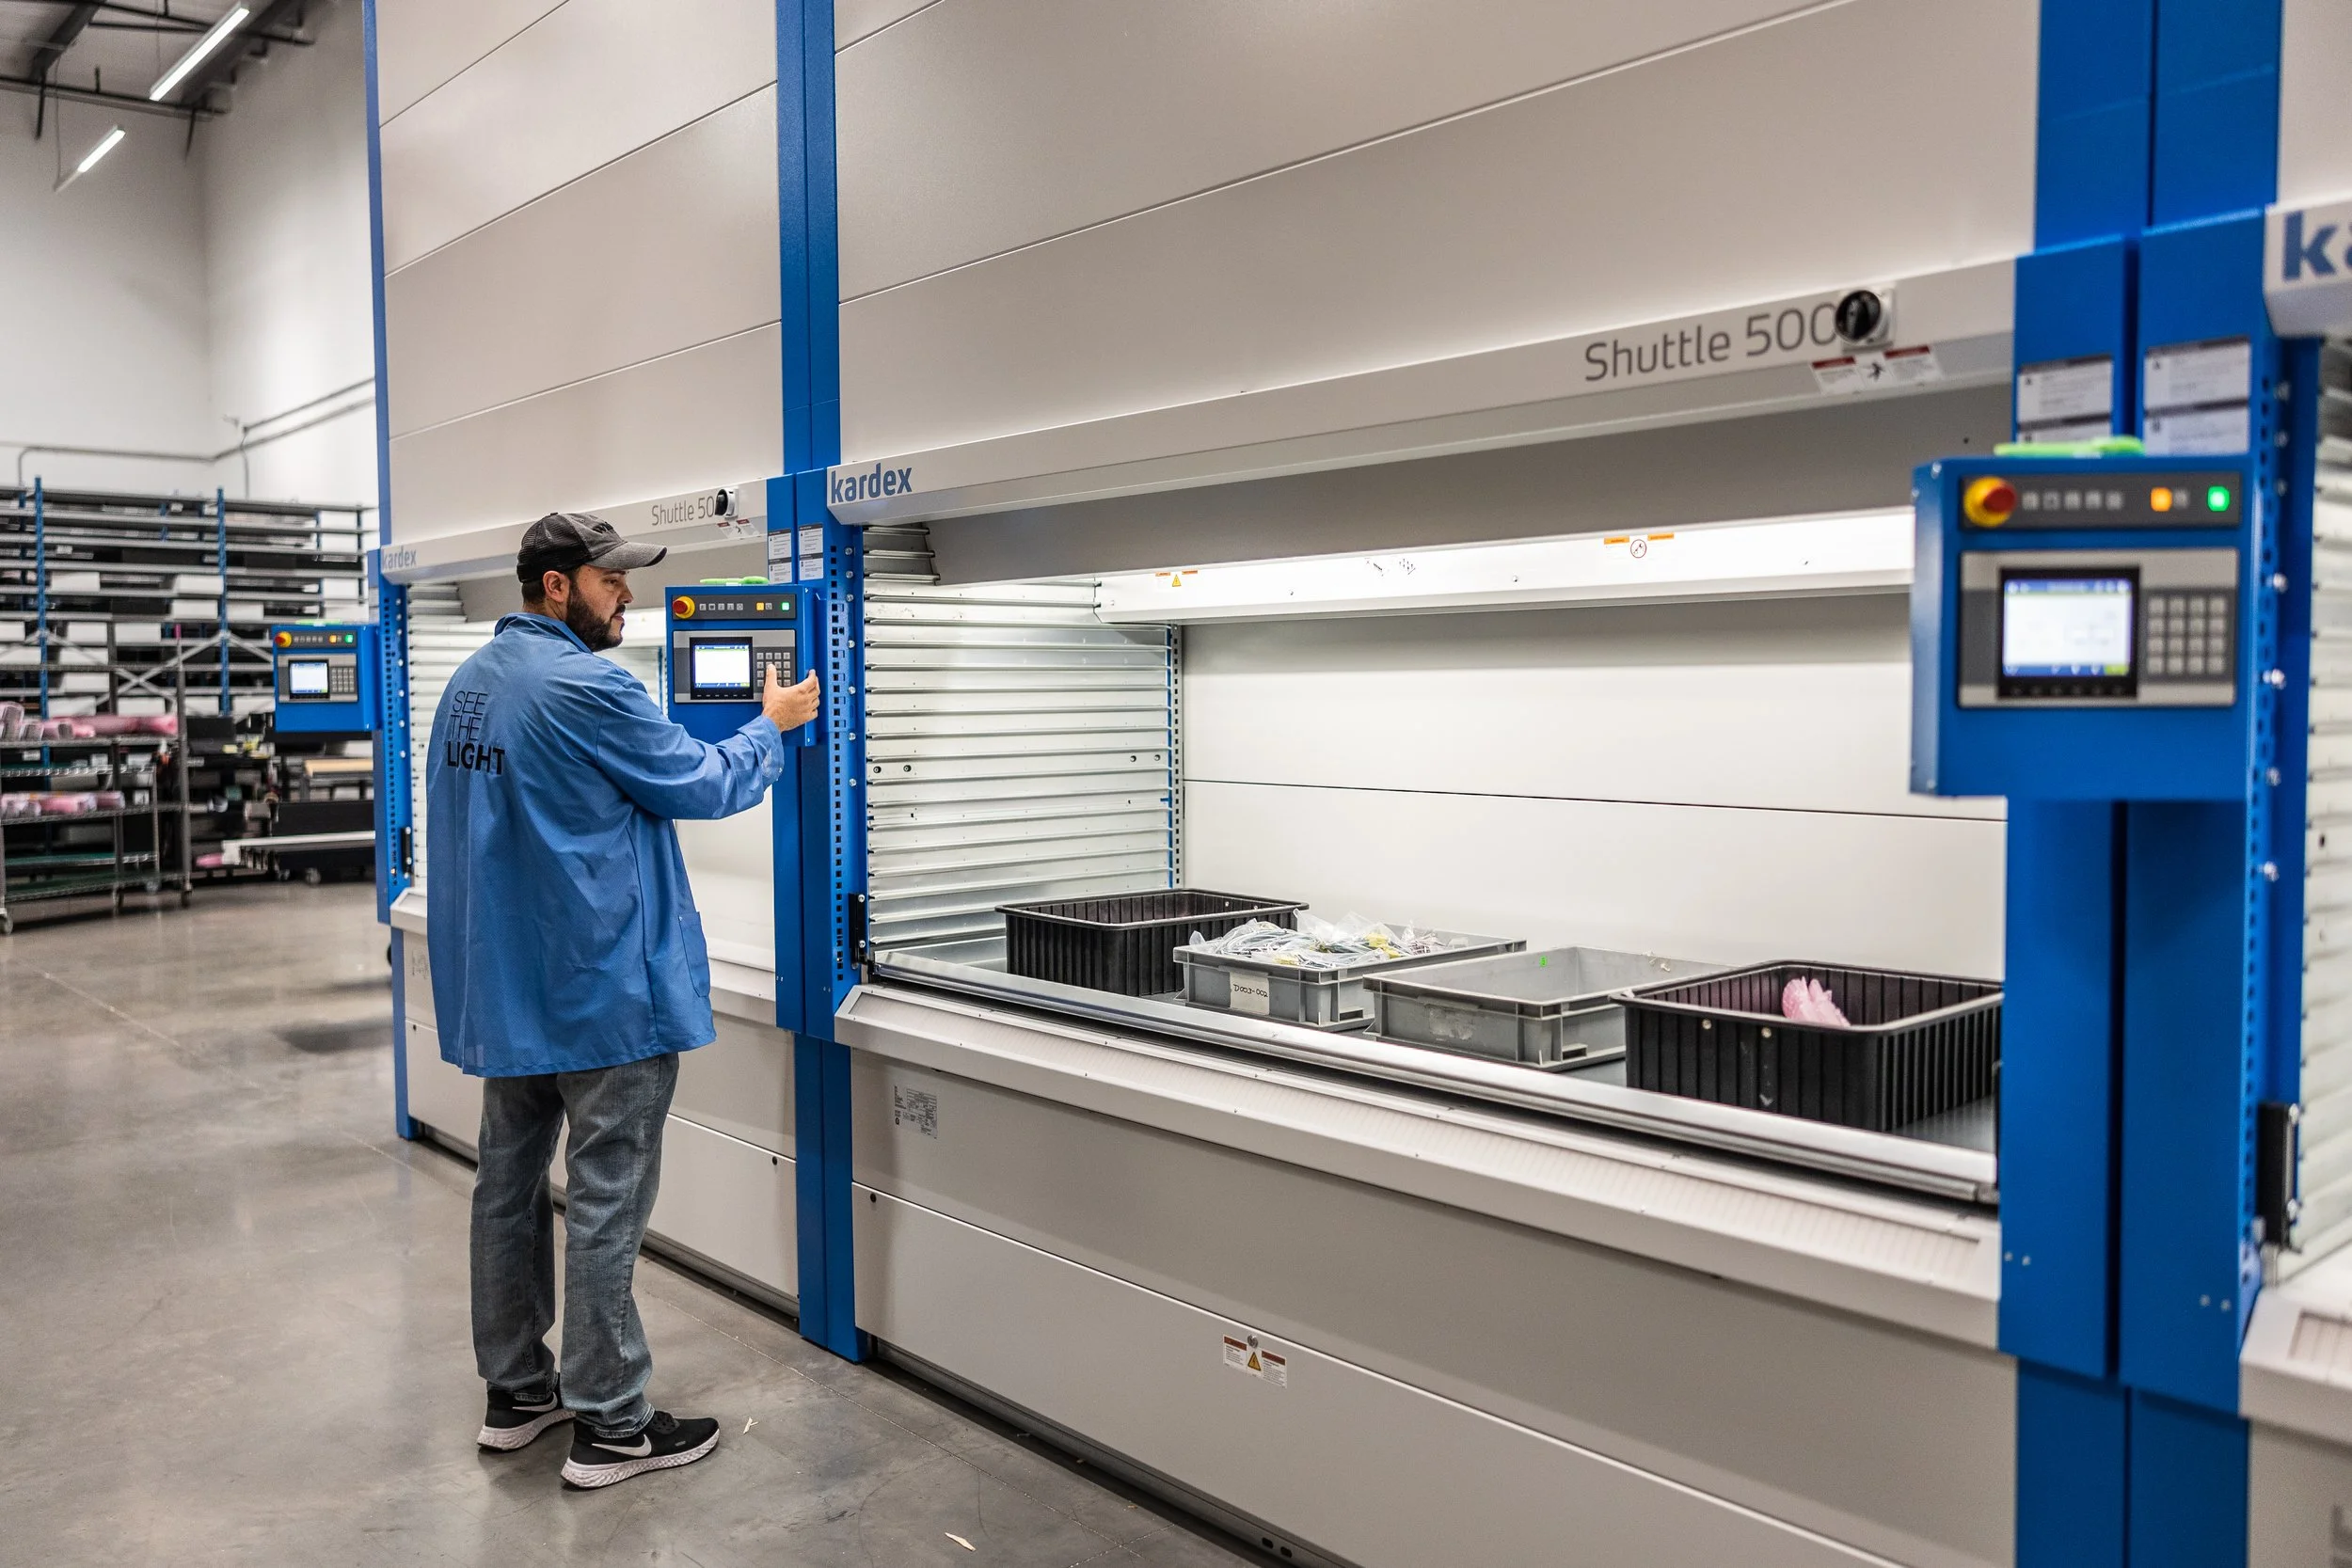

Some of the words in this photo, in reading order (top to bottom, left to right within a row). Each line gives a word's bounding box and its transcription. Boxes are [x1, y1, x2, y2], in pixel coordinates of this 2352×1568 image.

[1584, 324, 1731, 382] Shuttle
[831, 462, 913, 504] kardex
[651, 499, 695, 526] Shuttle
[381, 545, 417, 571] kardex
[453, 690, 488, 715] SEE
[450, 714, 483, 741] THE
[446, 740, 505, 776] LIGHT
